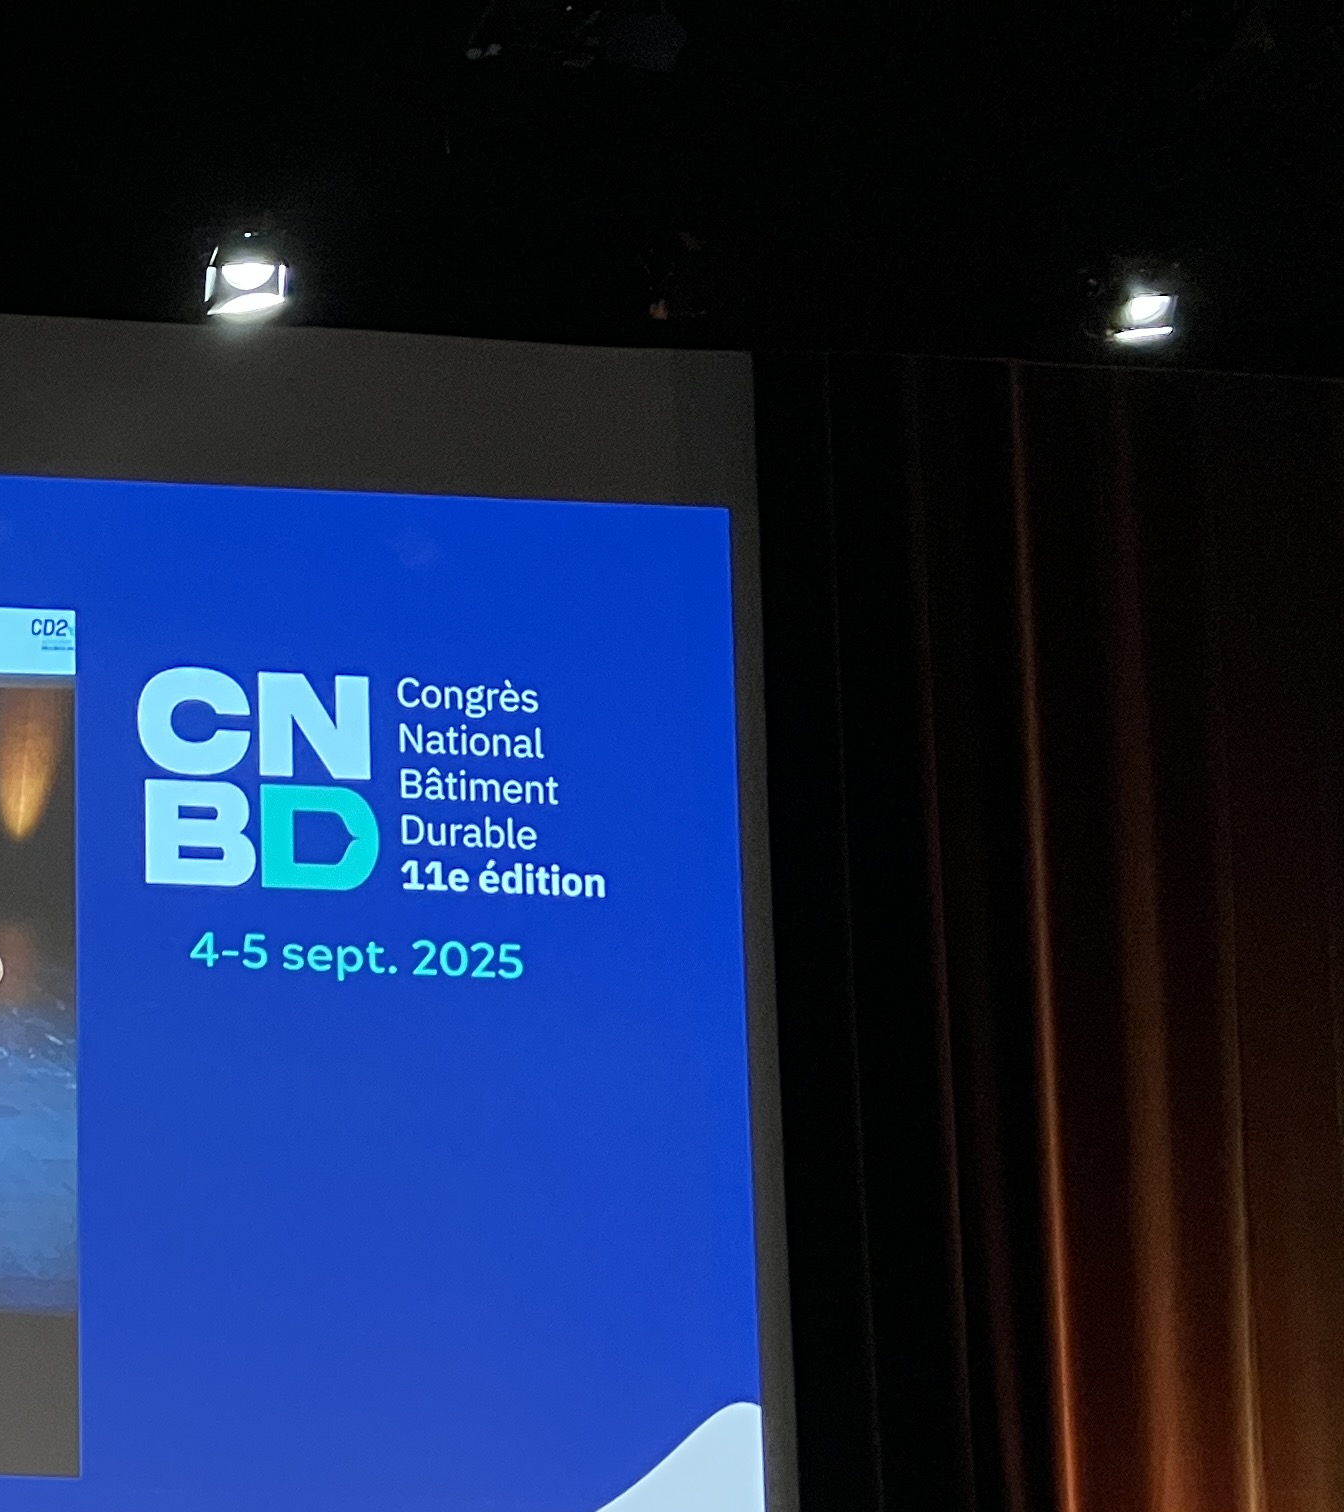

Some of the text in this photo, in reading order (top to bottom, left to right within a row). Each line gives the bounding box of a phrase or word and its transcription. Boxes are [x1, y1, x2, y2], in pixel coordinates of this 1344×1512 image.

[31, 618, 74, 637] CD2
[397, 677, 539, 719] Congrès
[398, 723, 545, 760] National
[399, 767, 559, 806] Bâtiment
[400, 814, 538, 850] Durable
[400, 859, 607, 898] 11e édition
[189, 931, 524, 981] 4-5 sept. 2025
